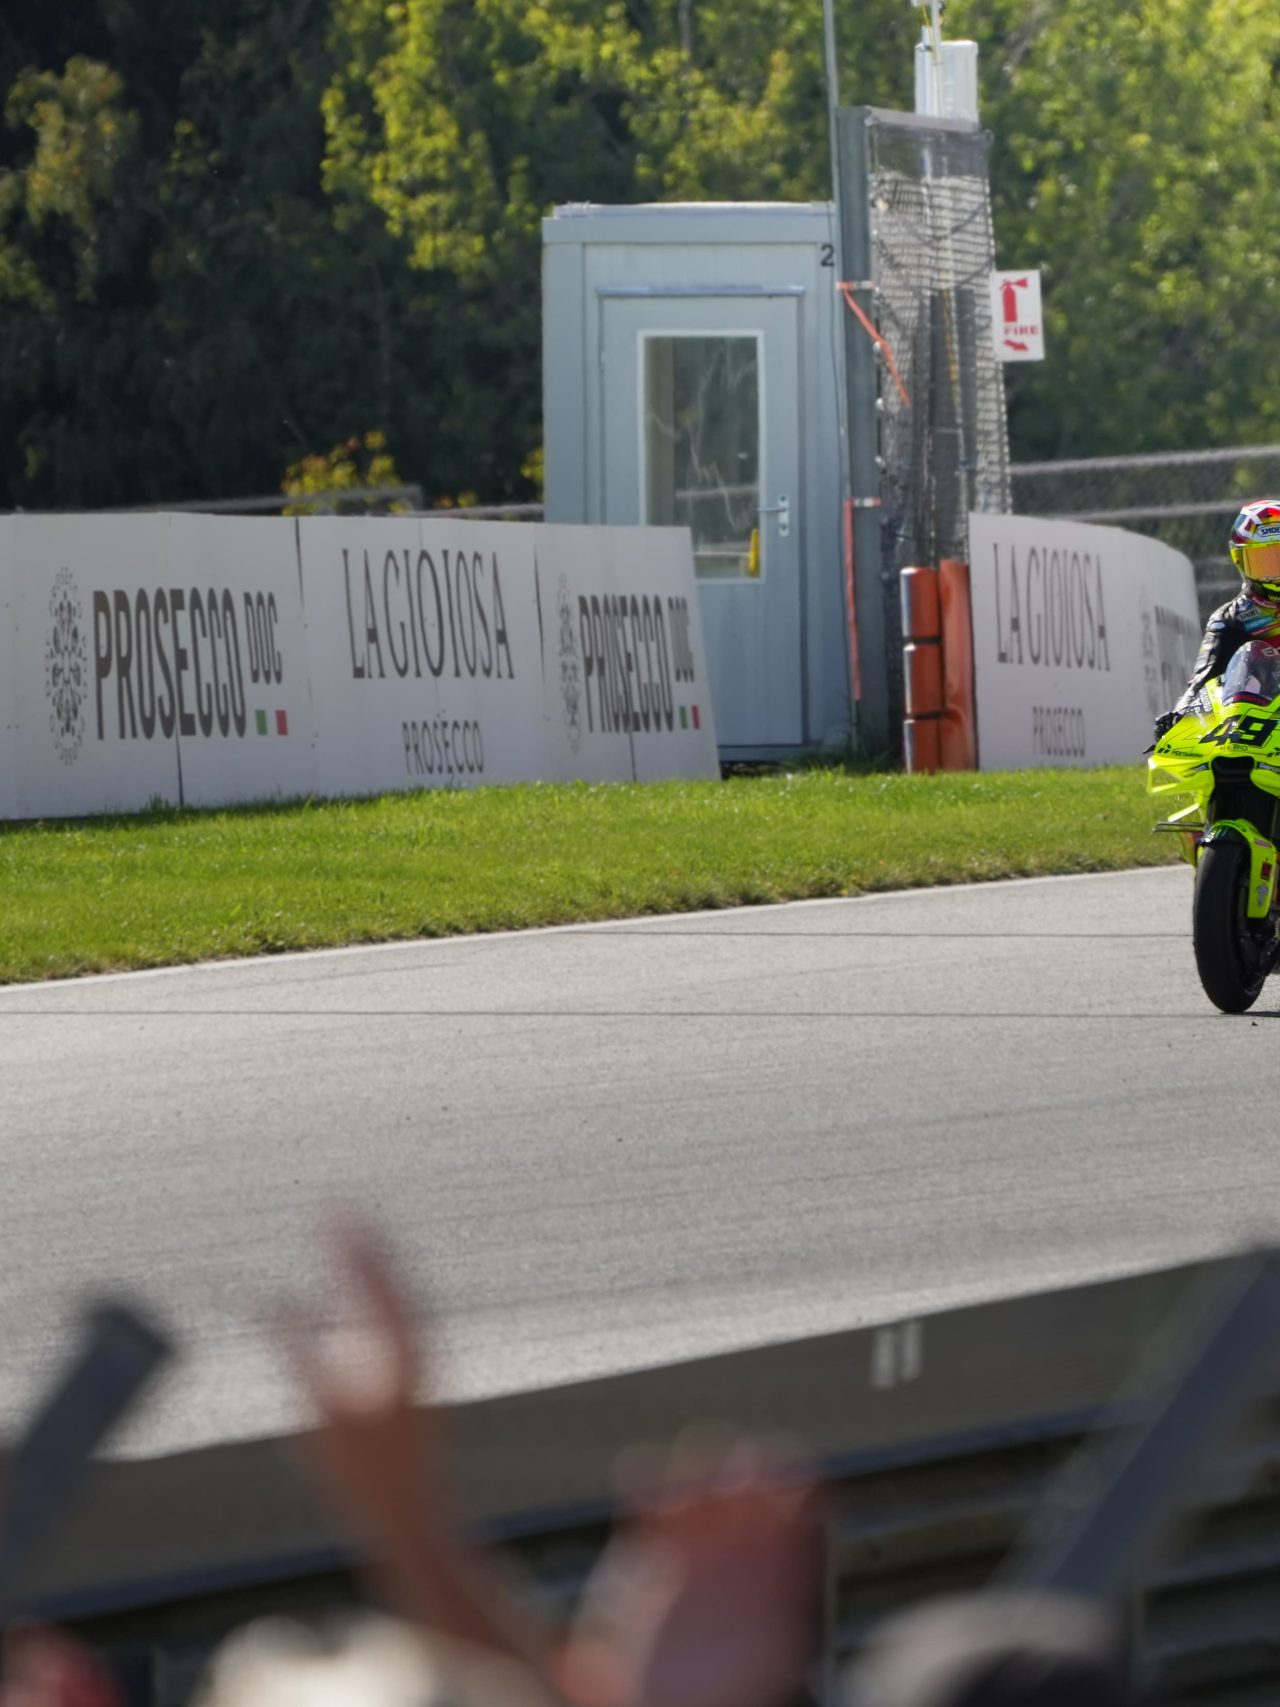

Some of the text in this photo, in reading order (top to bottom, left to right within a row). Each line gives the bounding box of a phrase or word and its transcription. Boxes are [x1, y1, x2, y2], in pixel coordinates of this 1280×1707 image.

[821, 244, 834, 267] 2
[1004, 325, 1038, 336] FIRE
[93, 587, 283, 740] PROSECCO DOC
[578, 594, 673, 734] PROSECCO
[402, 720, 484, 774] PROSECCO
[1199, 715, 1278, 747] 49
